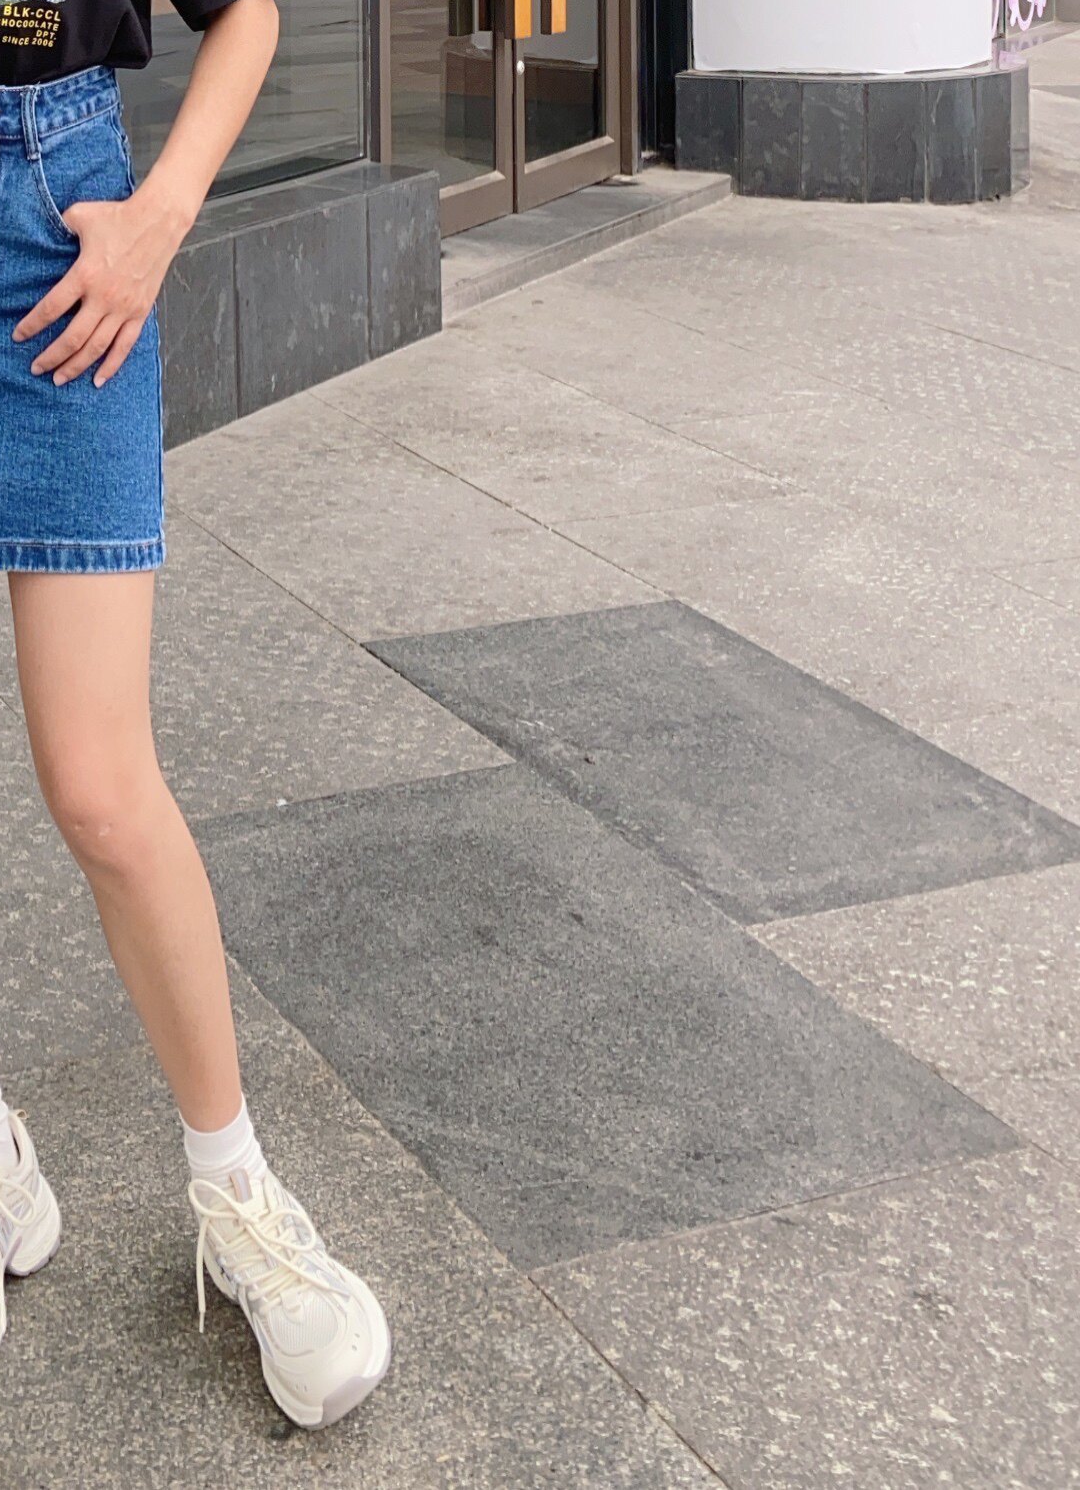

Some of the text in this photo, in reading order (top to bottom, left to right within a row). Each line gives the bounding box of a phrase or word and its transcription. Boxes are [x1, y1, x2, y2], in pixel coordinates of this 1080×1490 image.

[3, 5, 61, 22] BLK-CCL
[36, 29, 57, 40] DPT.
[1, 35, 54, 48] SINCE 2006
